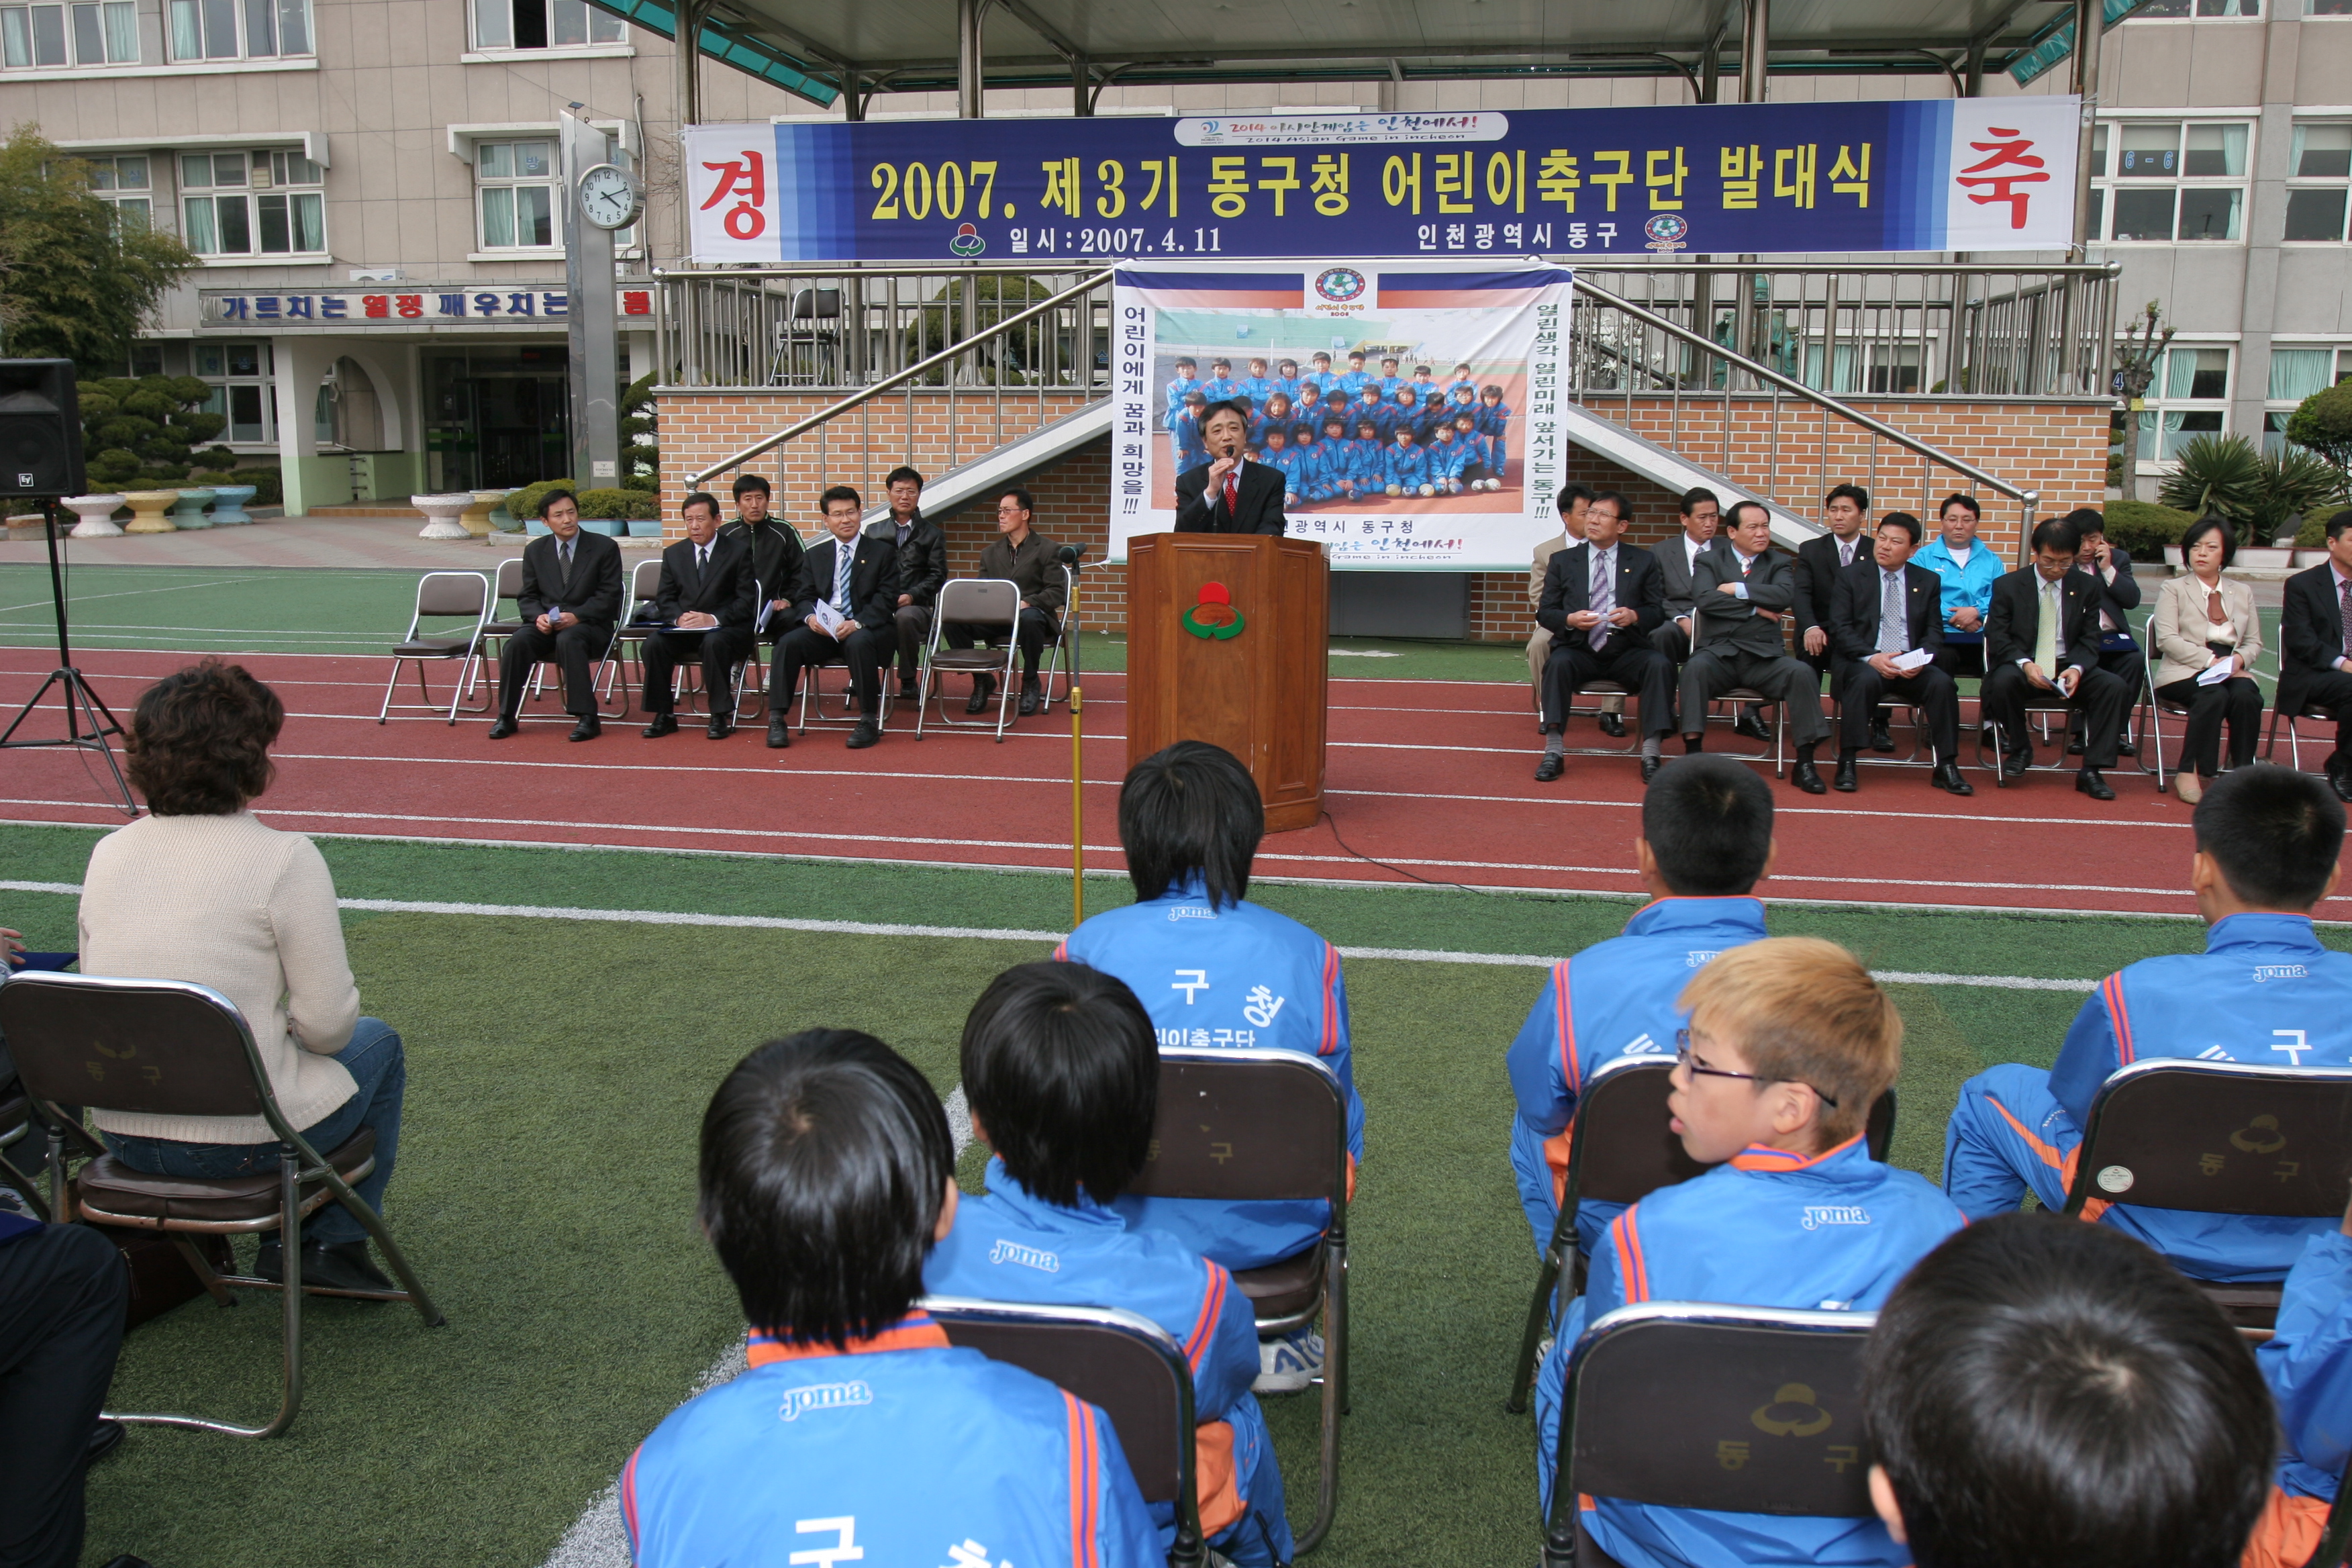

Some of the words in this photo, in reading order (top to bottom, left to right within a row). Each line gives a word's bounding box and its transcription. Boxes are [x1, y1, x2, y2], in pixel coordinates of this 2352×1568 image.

[1229, 123, 1267, 133] 2014
[1270, 120, 1370, 134] 아시안게임은
[1378, 115, 1478, 132] 인천에서!
[594, 174, 601, 183] 11
[603, 170, 611, 179] 12
[615, 173, 619, 182] 1
[1208, 152, 1350, 219] 동구청
[1381, 145, 1688, 215] 어린이축구단
[1720, 142, 1871, 212] 발대식
[586, 182, 594, 191] 10
[700, 150, 767, 241] 경
[1955, 126, 2052, 230] 축
[585, 193, 589, 201] 9
[626, 192, 631, 201] 3
[589, 204, 593, 213] 8
[624, 203, 628, 212] 4
[597, 211, 601, 219] 7
[606, 214, 611, 223] 6
[616, 211, 621, 219] 5
[1417, 222, 1553, 250] 인천광역시
[1567, 221, 1618, 248] 동구
[222, 296, 347, 320] 가르치는
[362, 294, 424, 318] 열정
[438, 291, 568, 316] 깨우치는
[1535, 303, 1559, 357] 열린생각
[1122, 307, 1146, 395] 어린이에게
[1533, 362, 1557, 415] 열린미래
[1122, 402, 1146, 436] 꿈과
[1531, 421, 1557, 474] 앞서가는
[1361, 520, 1414, 534] 동구청
[1371, 537, 1464, 552] 인천에서!
